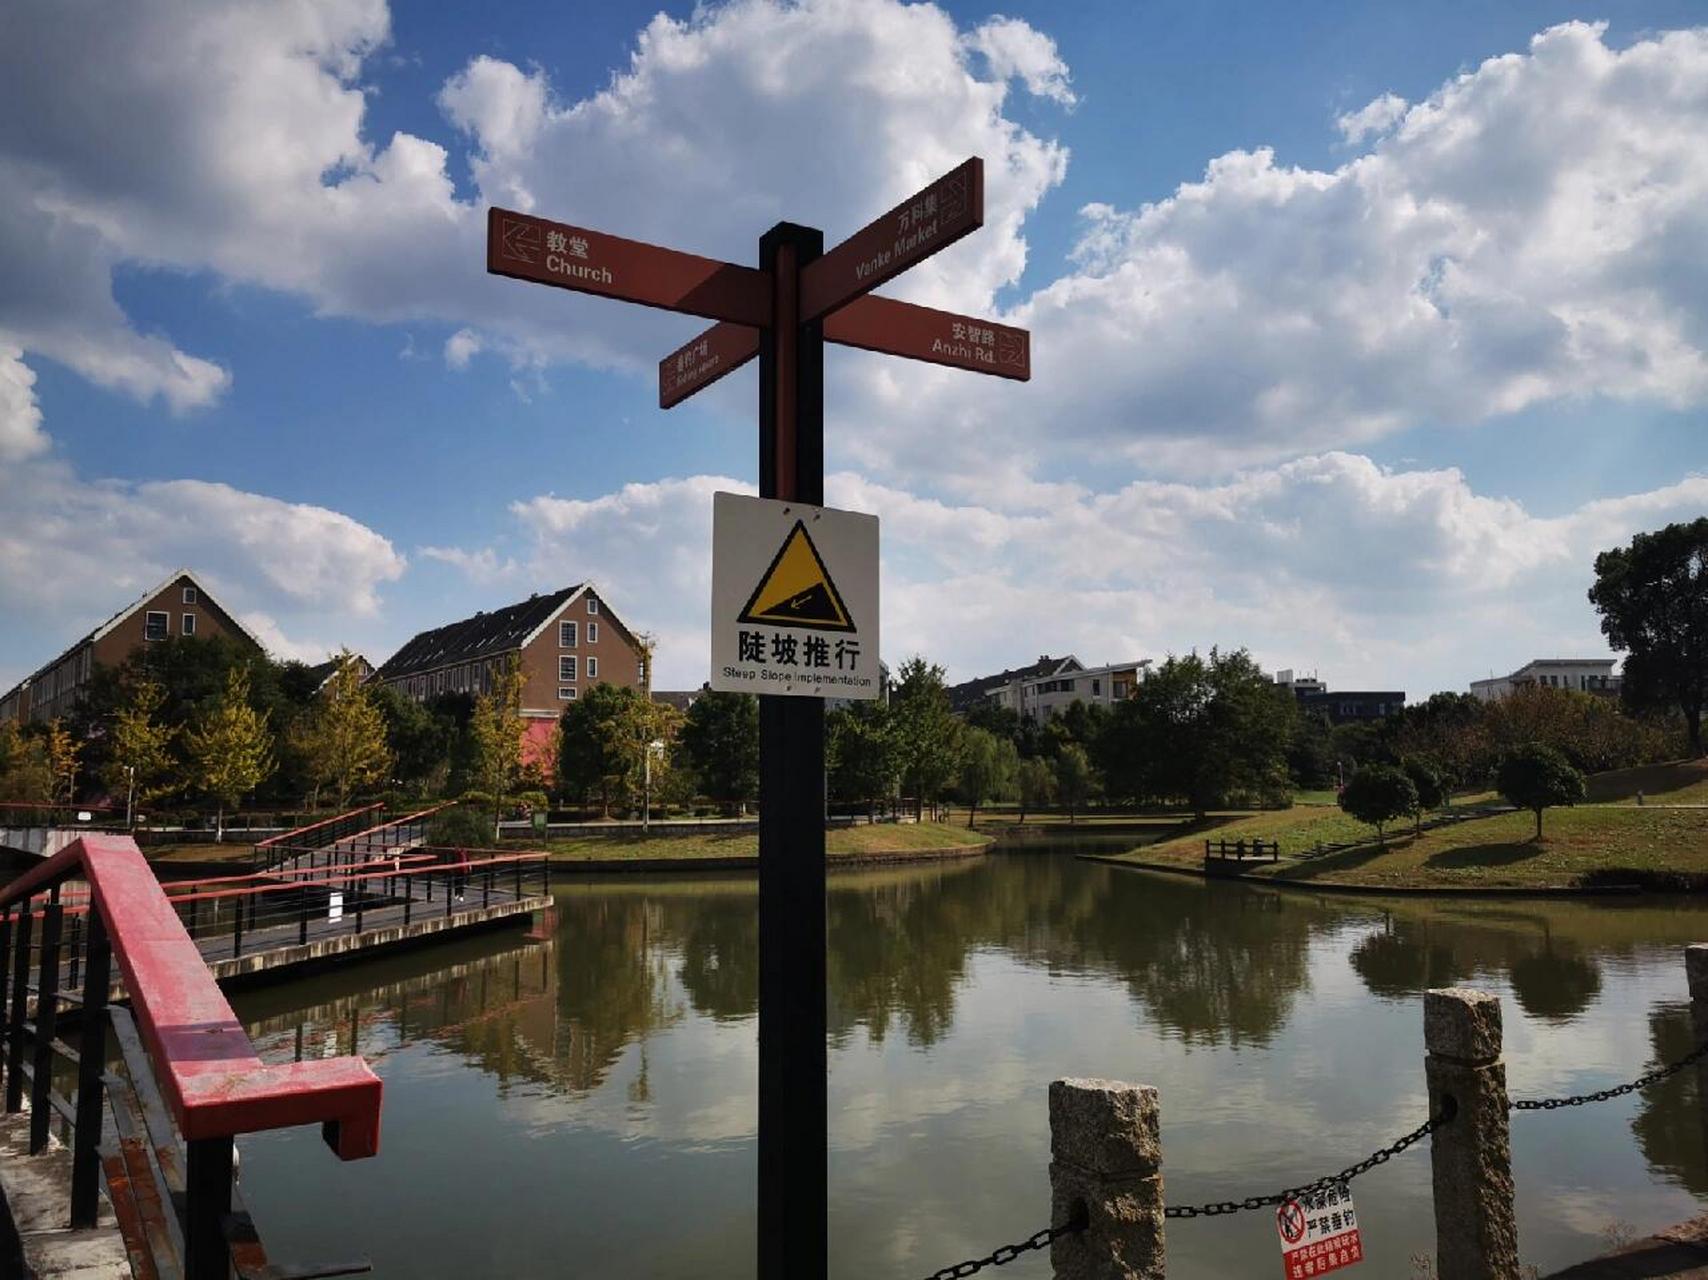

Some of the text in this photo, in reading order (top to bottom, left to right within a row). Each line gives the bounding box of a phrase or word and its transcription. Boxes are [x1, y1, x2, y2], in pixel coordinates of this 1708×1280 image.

[546, 229, 589, 259] 教堂
[856, 219, 938, 280] Vanke Market
[546, 255, 613, 284] Church
[932, 338, 972, 359] Anzhi
[952, 322, 995, 347] 安智路
[738, 631, 861, 671] 陡坡推行
[723, 666, 871, 688] Steep Slope Implementation
[1306, 1208, 1355, 1239] 严禁垂钓
